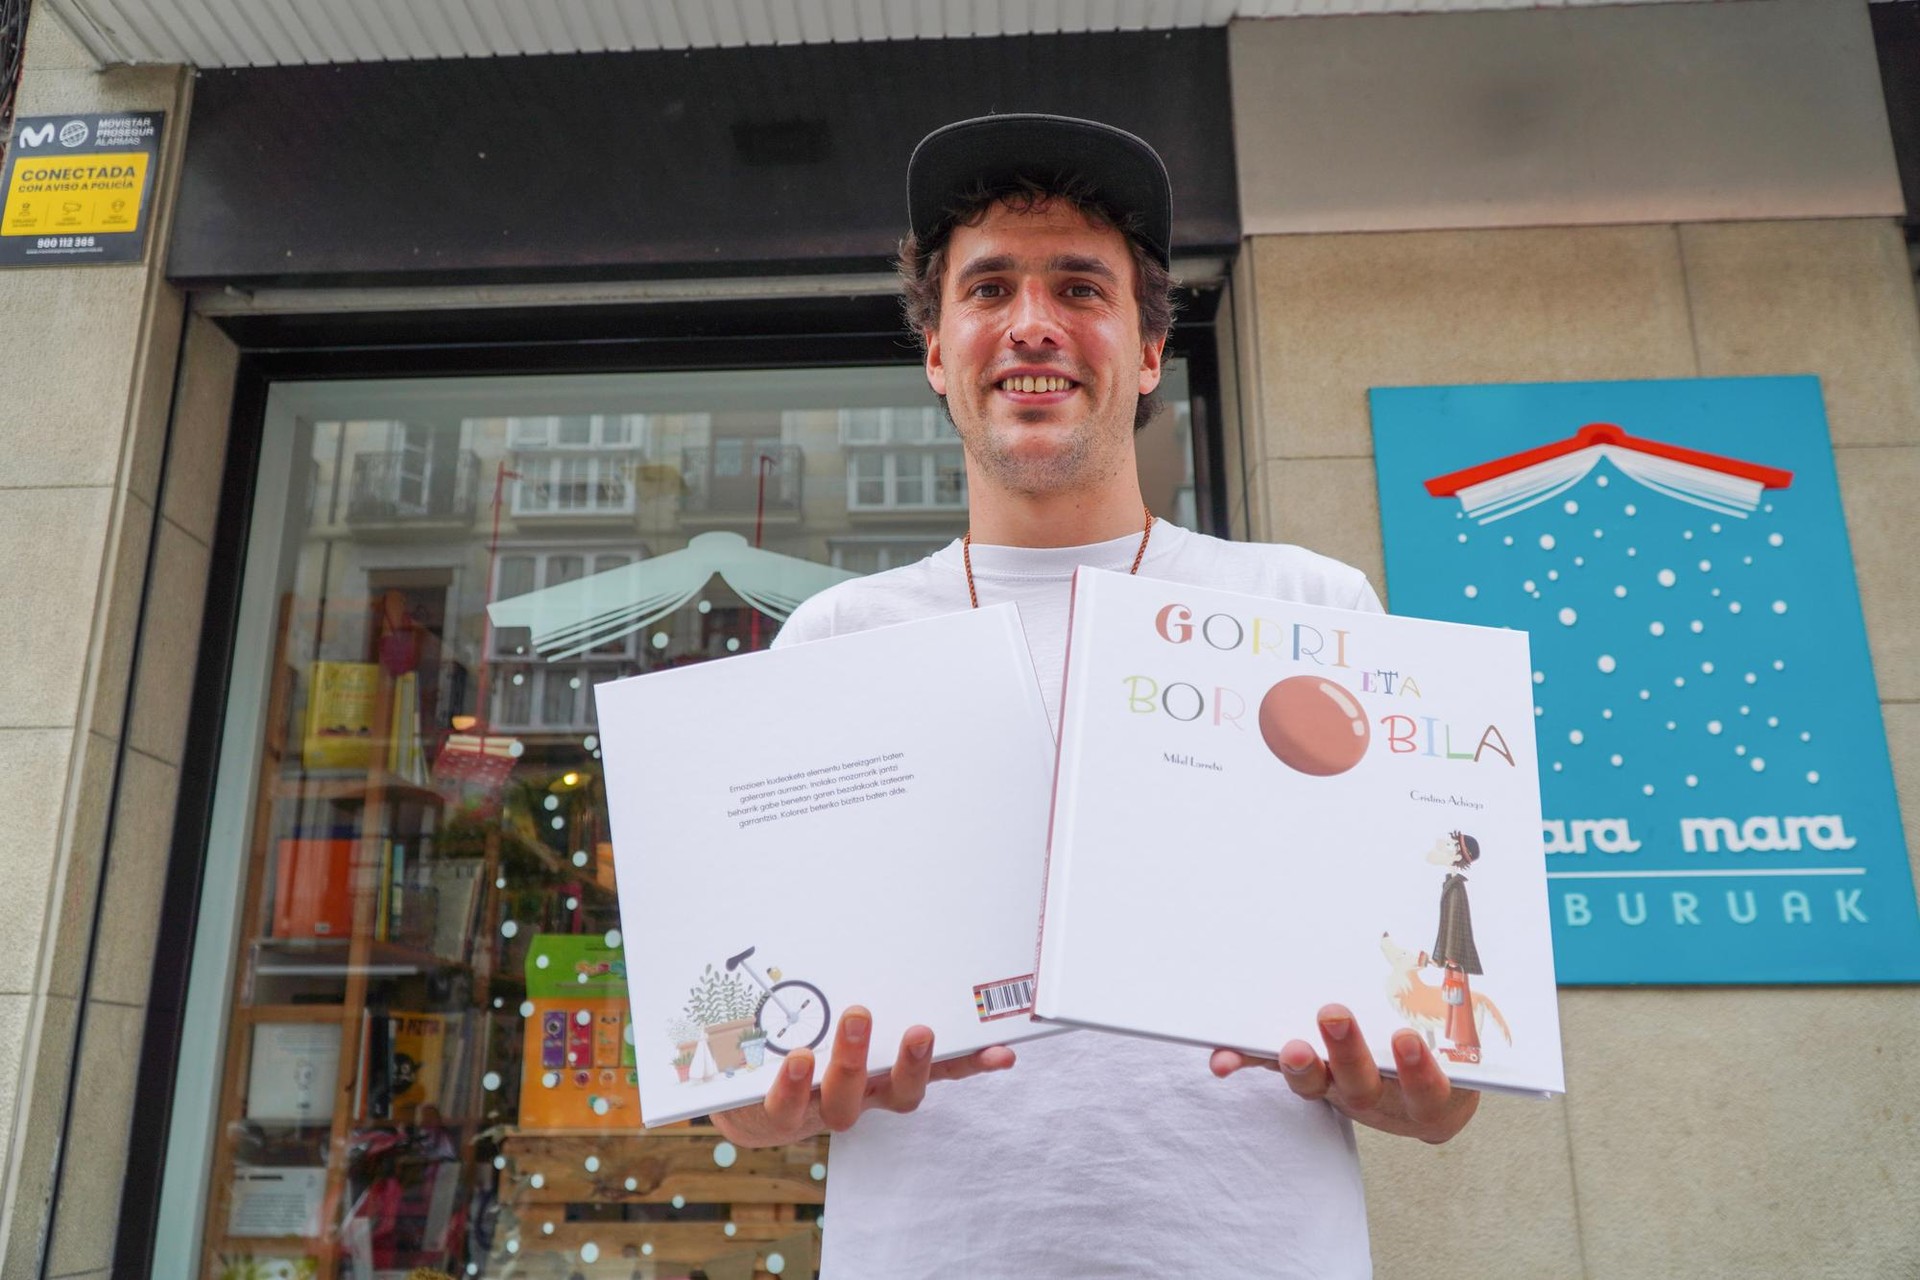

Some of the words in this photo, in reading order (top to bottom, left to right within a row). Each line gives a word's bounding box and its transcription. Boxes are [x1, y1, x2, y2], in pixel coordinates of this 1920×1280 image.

[96, 127, 154, 138] PROSEGUR
[98, 117, 151, 128] MOVISTAR
[95, 137, 141, 146] ALARMAS
[18, 183, 43, 193] CON
[45, 183, 79, 192] AVISO
[81, 182, 88, 191] A
[21, 166, 136, 182] CONECTADA
[37, 237, 58, 249] 900
[59, 237, 74, 248] 112
[1155, 603, 1352, 669] GORRI
[1359, 668, 1423, 699] ETA
[739, 789, 776, 805] galeraren
[878, 764, 899, 778] jantzi
[766, 771, 806, 788] kudeaketa
[806, 764, 841, 779] elementu
[842, 756, 882, 771] bereizgarri
[882, 751, 904, 763] baten
[727, 803, 759, 818] beharrik
[759, 800, 780, 813] gabe
[780, 794, 812, 807] benetan
[812, 789, 835, 802] garen
[836, 780, 880, 796] bezalakoak
[880, 773, 915, 788] izatearen
[780, 806, 809, 819] Kolorez
[865, 790, 888, 803] baten
[1542, 818, 1642, 855] ara
[1680, 815, 1857, 853] mara
[1564, 889, 1869, 926] BURUAK
